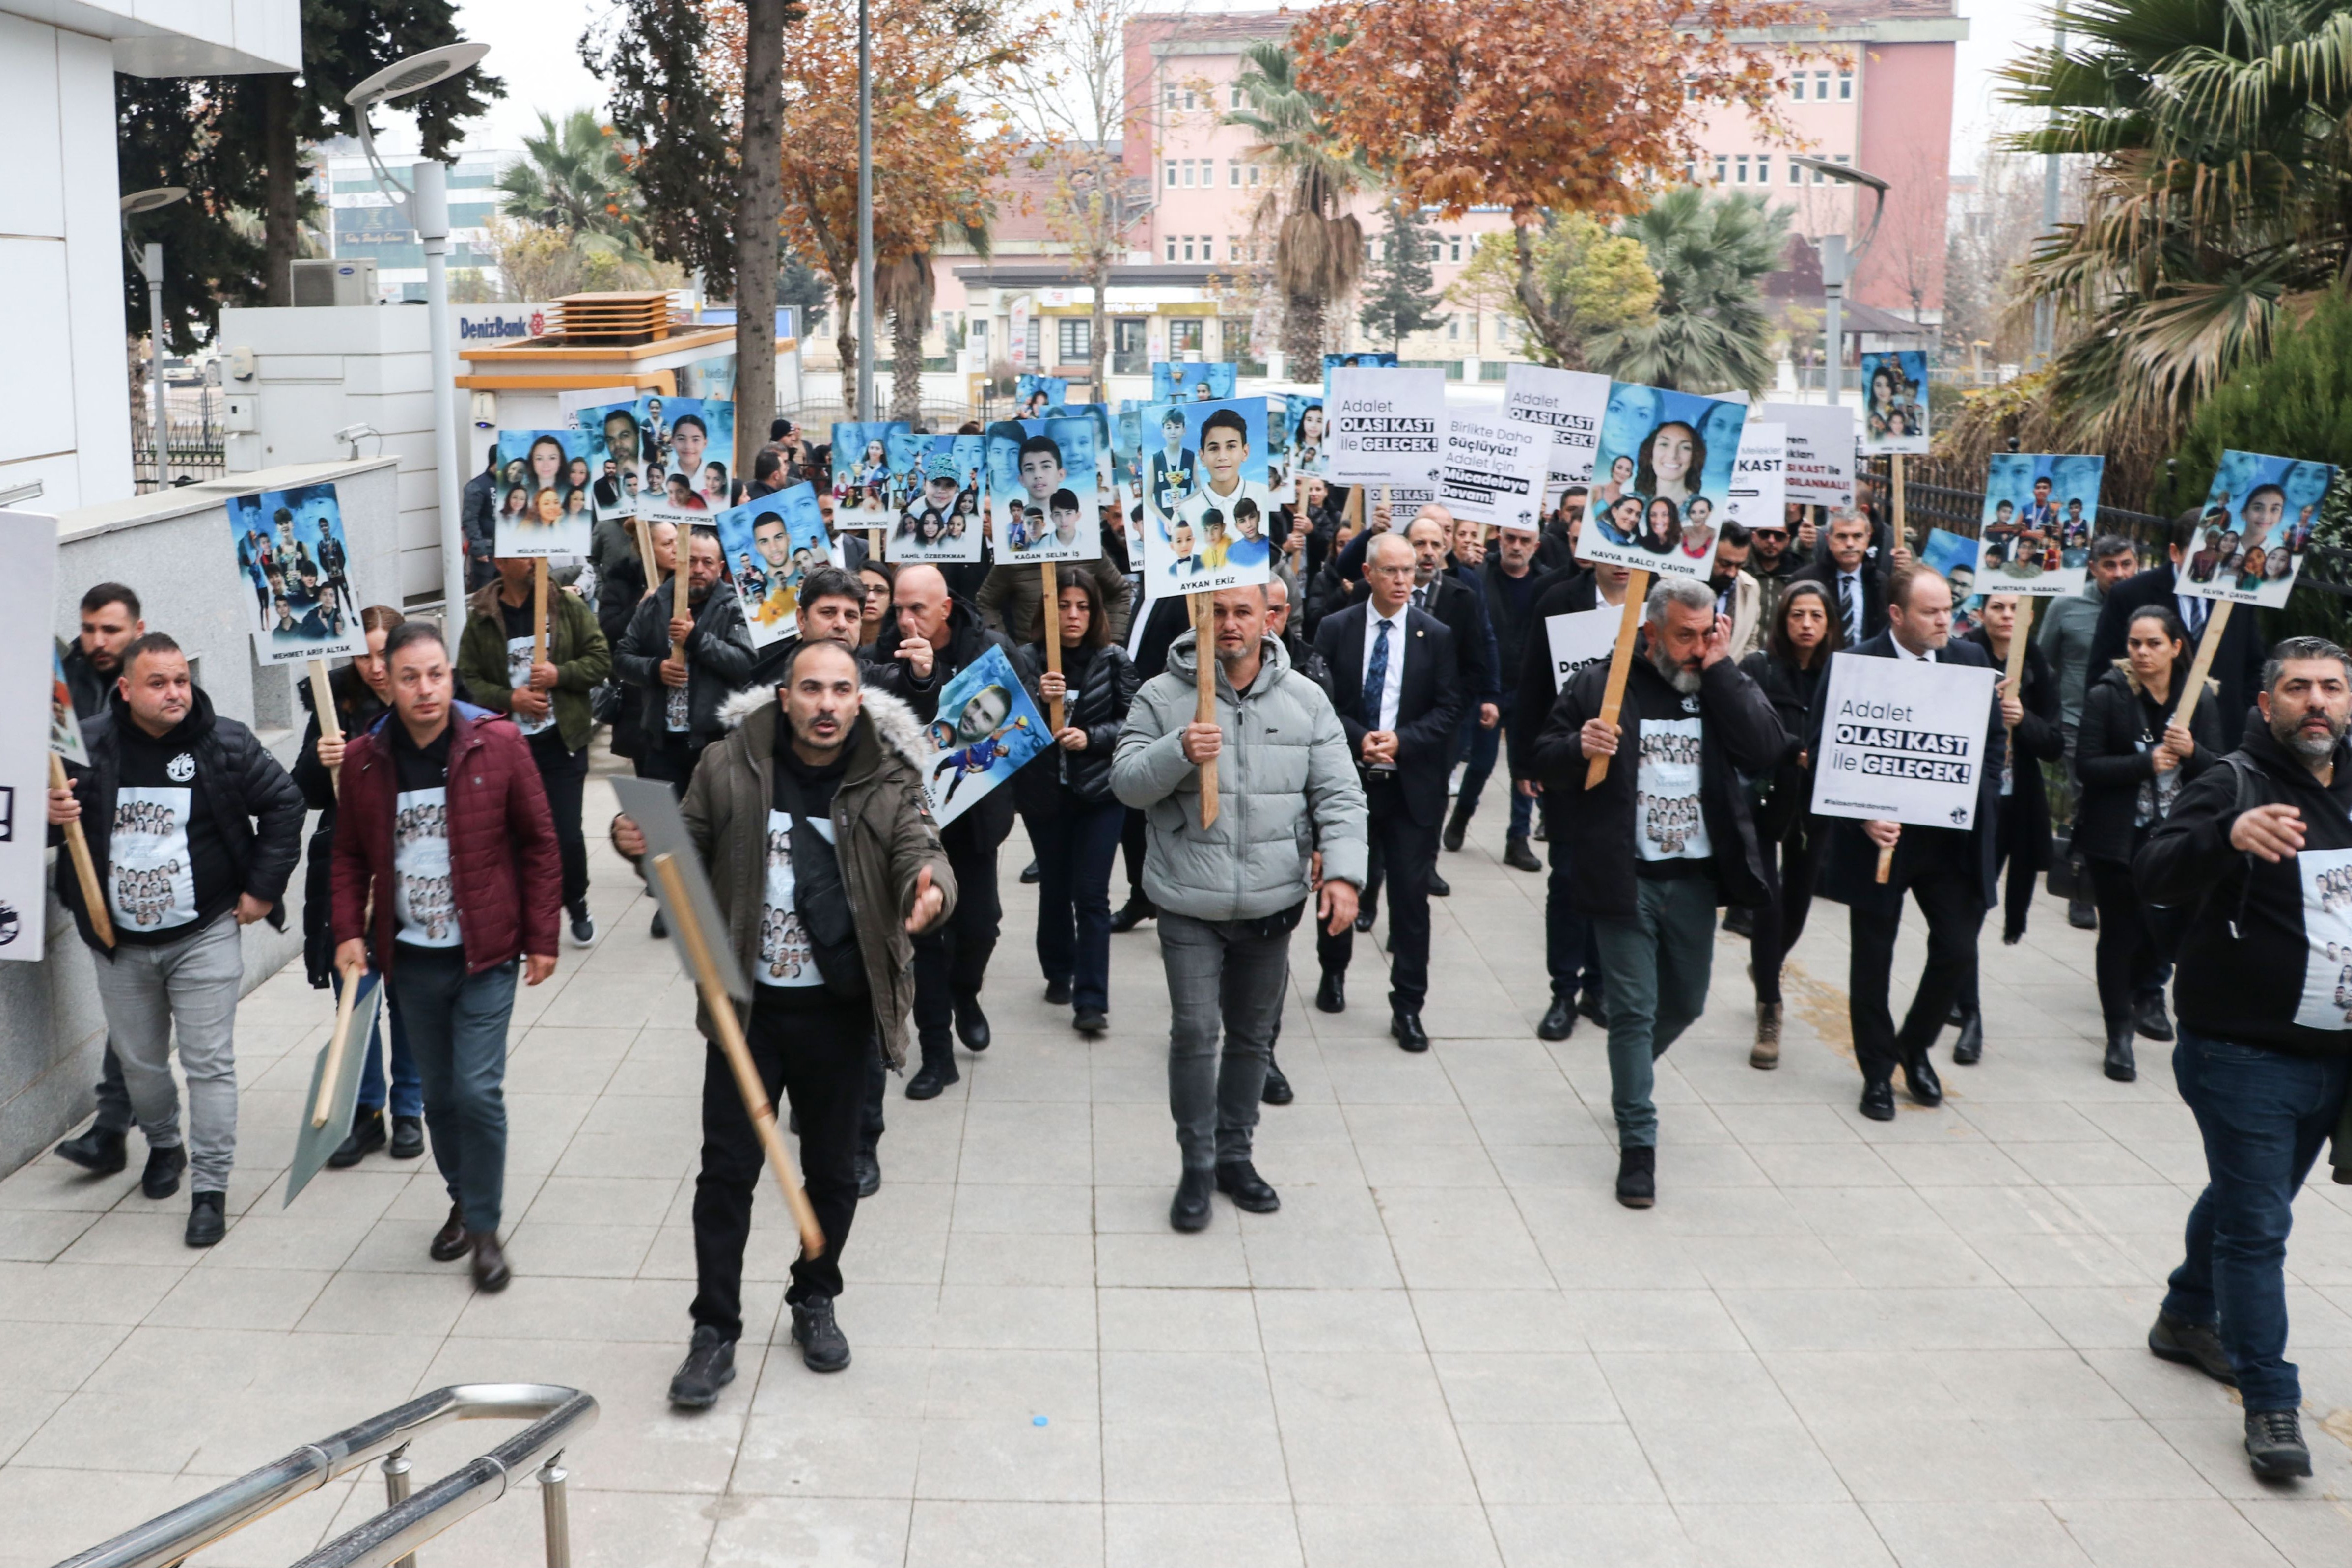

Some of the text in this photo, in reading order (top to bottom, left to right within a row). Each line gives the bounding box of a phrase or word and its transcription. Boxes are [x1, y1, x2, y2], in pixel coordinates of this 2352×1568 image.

[461, 316, 526, 339] DenizBank
[1341, 400, 1393, 412] Adalet
[1513, 393, 1559, 408] Adalet
[1341, 418, 1434, 432] OLASI KAST
[1511, 408, 1594, 430] OLASI KAST
[1451, 421, 1532, 444] Birlikte Daha
[1553, 431, 1595, 448] ECEK!
[1363, 438, 1437, 451] GELECEK!
[1449, 437, 1518, 457] Güçlüyüz!
[1446, 452, 1515, 473] Adalet İçin
[1739, 460, 1782, 471] KAST
[1798, 464, 1825, 474] KAST
[1444, 467, 1529, 493] Mücadeleye
[1404, 490, 1433, 501] KAST
[1441, 485, 1495, 504] Devam!
[1591, 550, 1695, 575] HAVVA BALCI ÇAVDIR
[1180, 576, 1236, 590] AYKAN EKİZ
[273, 645, 351, 660] MEHMET ARİF ALTAK
[1840, 699, 1913, 723] Adalet
[1836, 724, 1969, 755] OLASI KAST
[1863, 756, 1970, 784] GELECEK!
